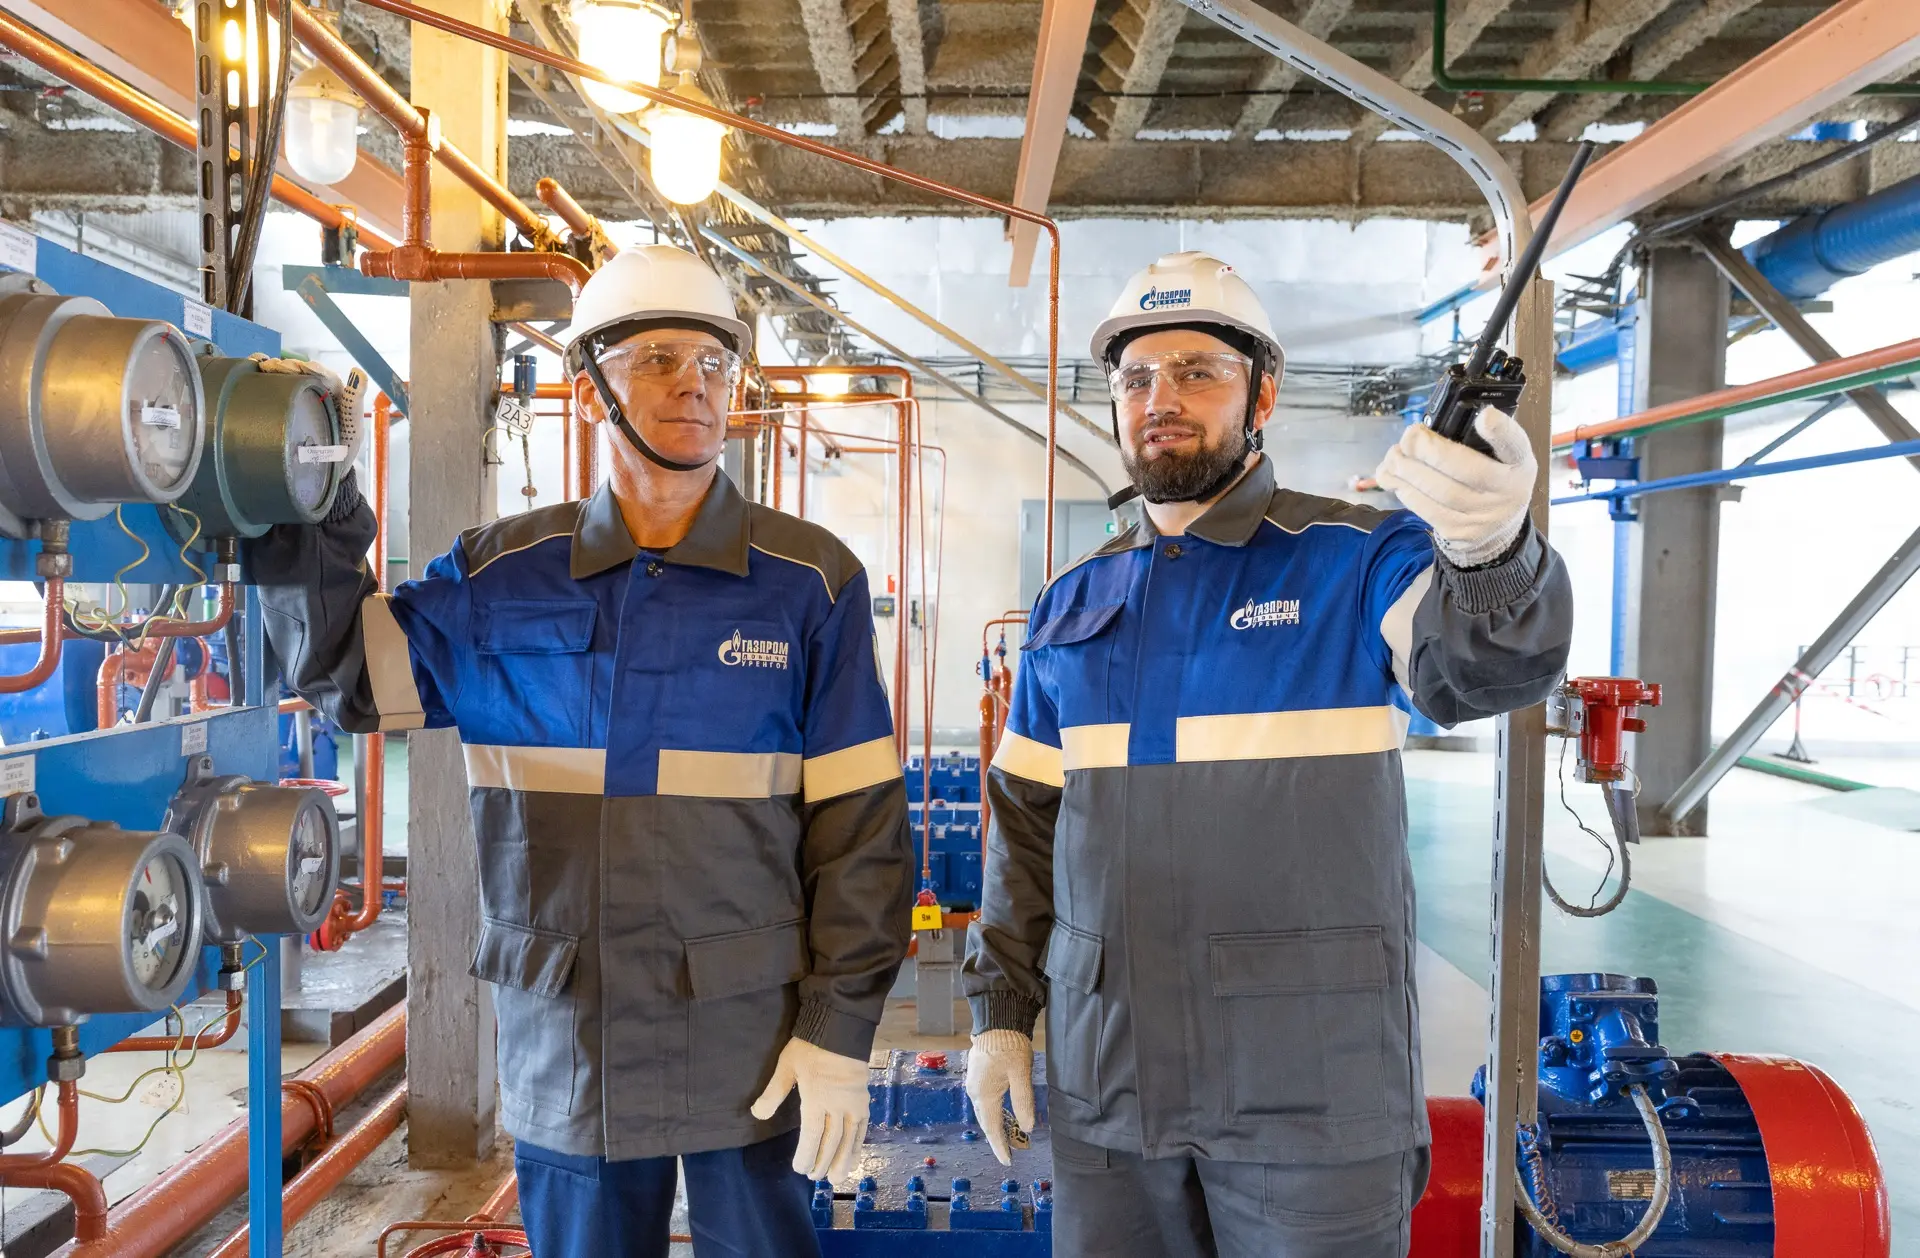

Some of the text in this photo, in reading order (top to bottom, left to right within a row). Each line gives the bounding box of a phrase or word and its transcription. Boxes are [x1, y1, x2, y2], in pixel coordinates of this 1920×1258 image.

[1157, 289, 1191, 300] ГАЗПРОМ
[1254, 600, 1299, 616] ГАЗПРОМ
[742, 639, 788, 655] ГАЗПРОМ
[741, 660, 788, 670] УРЕНГОЙ
